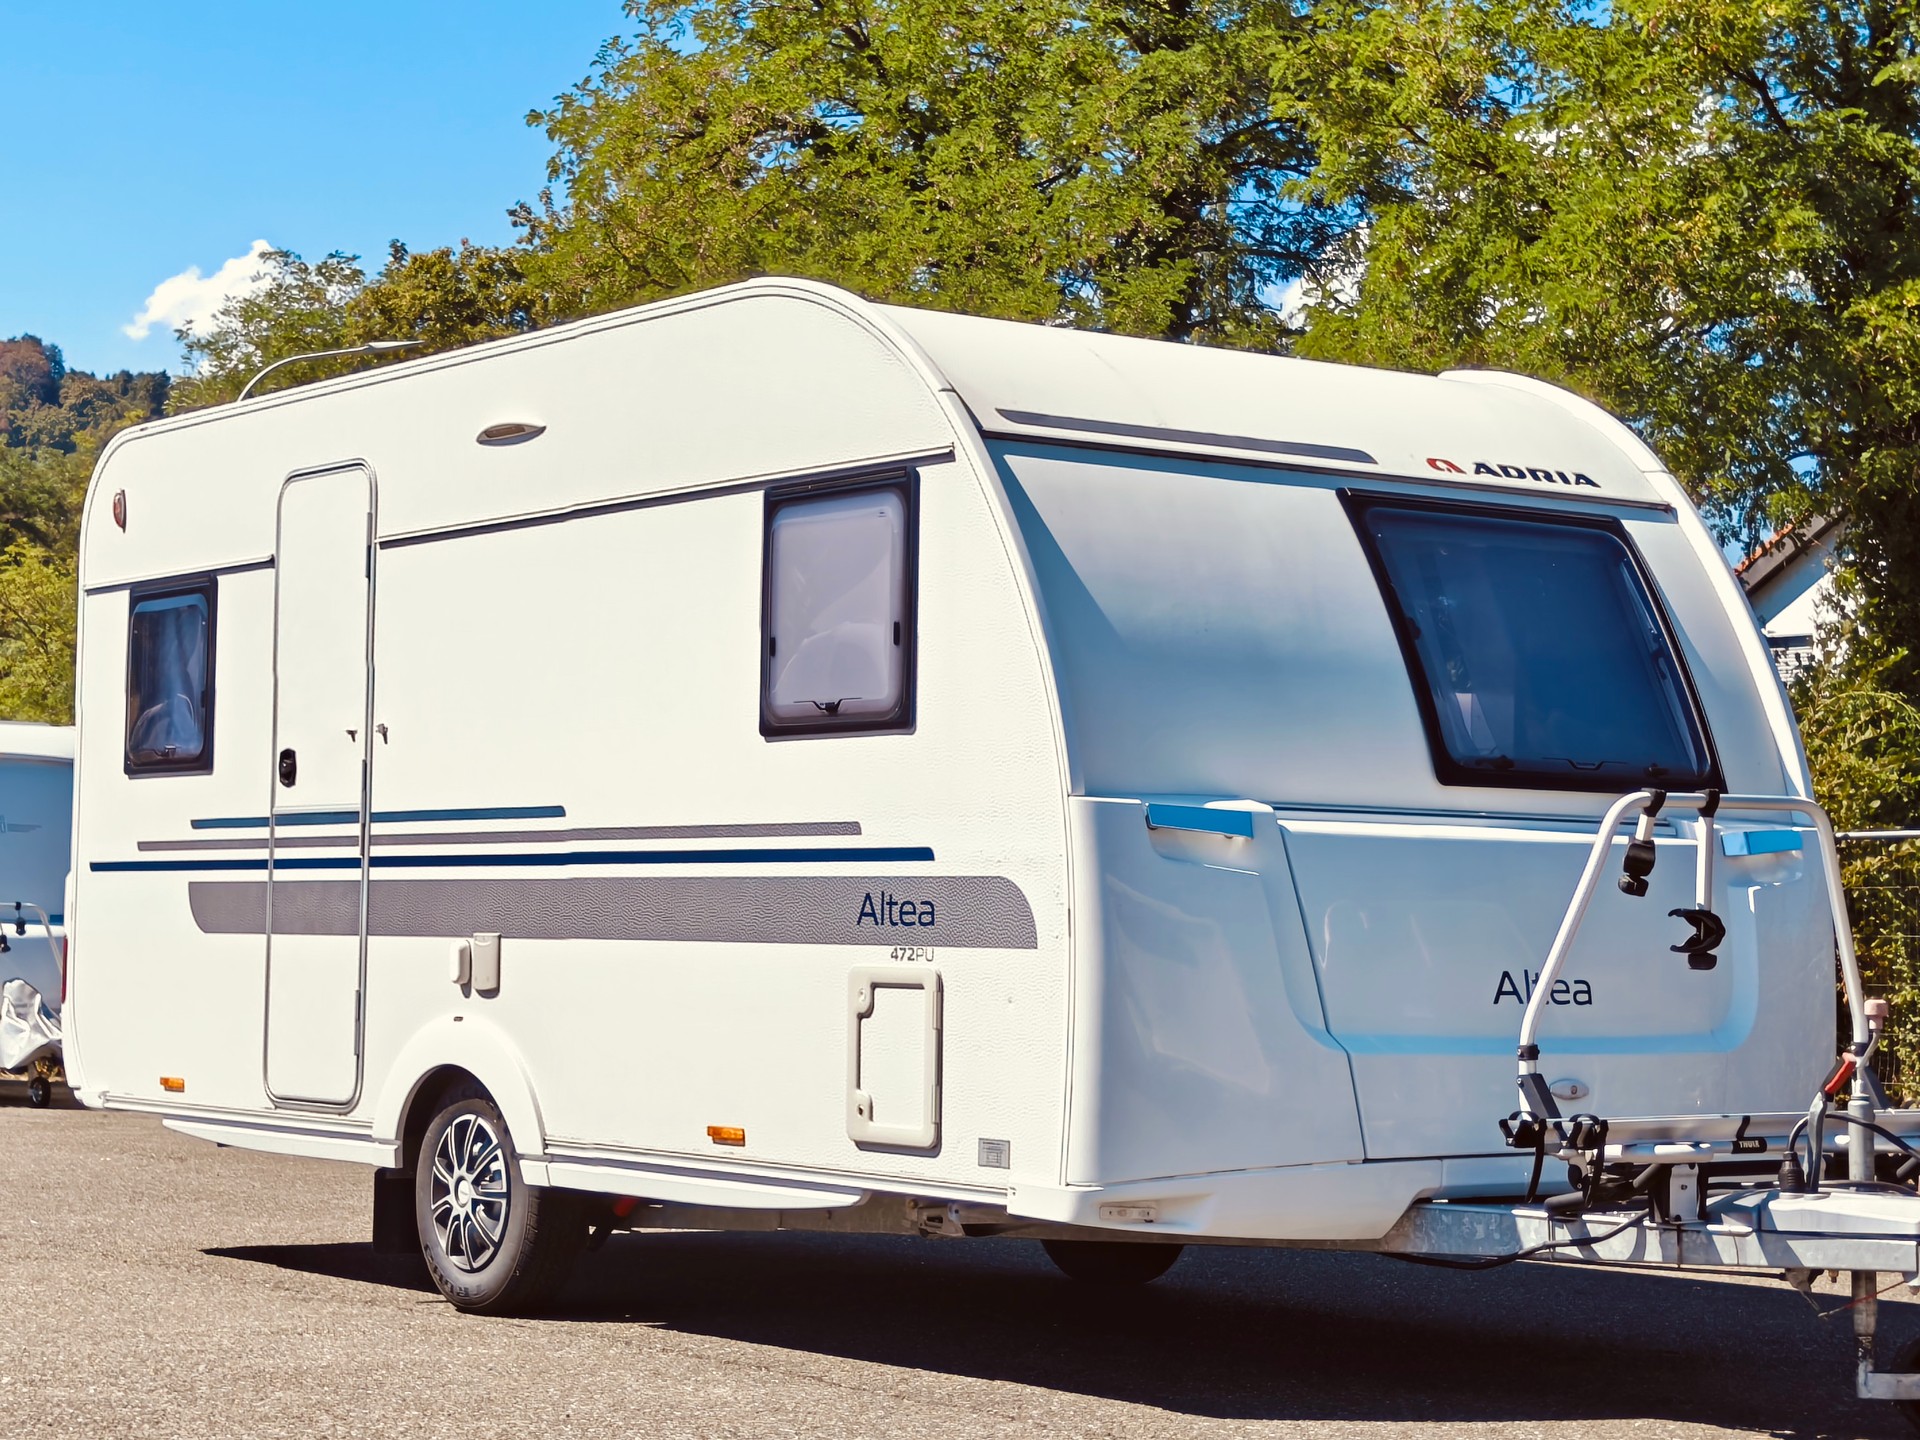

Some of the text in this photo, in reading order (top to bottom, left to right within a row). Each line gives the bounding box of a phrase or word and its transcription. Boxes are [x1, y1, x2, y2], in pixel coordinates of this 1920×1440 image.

[1472, 462, 1602, 489] ADRIA
[856, 890, 935, 927] Altea
[890, 947, 935, 962] 472PU
